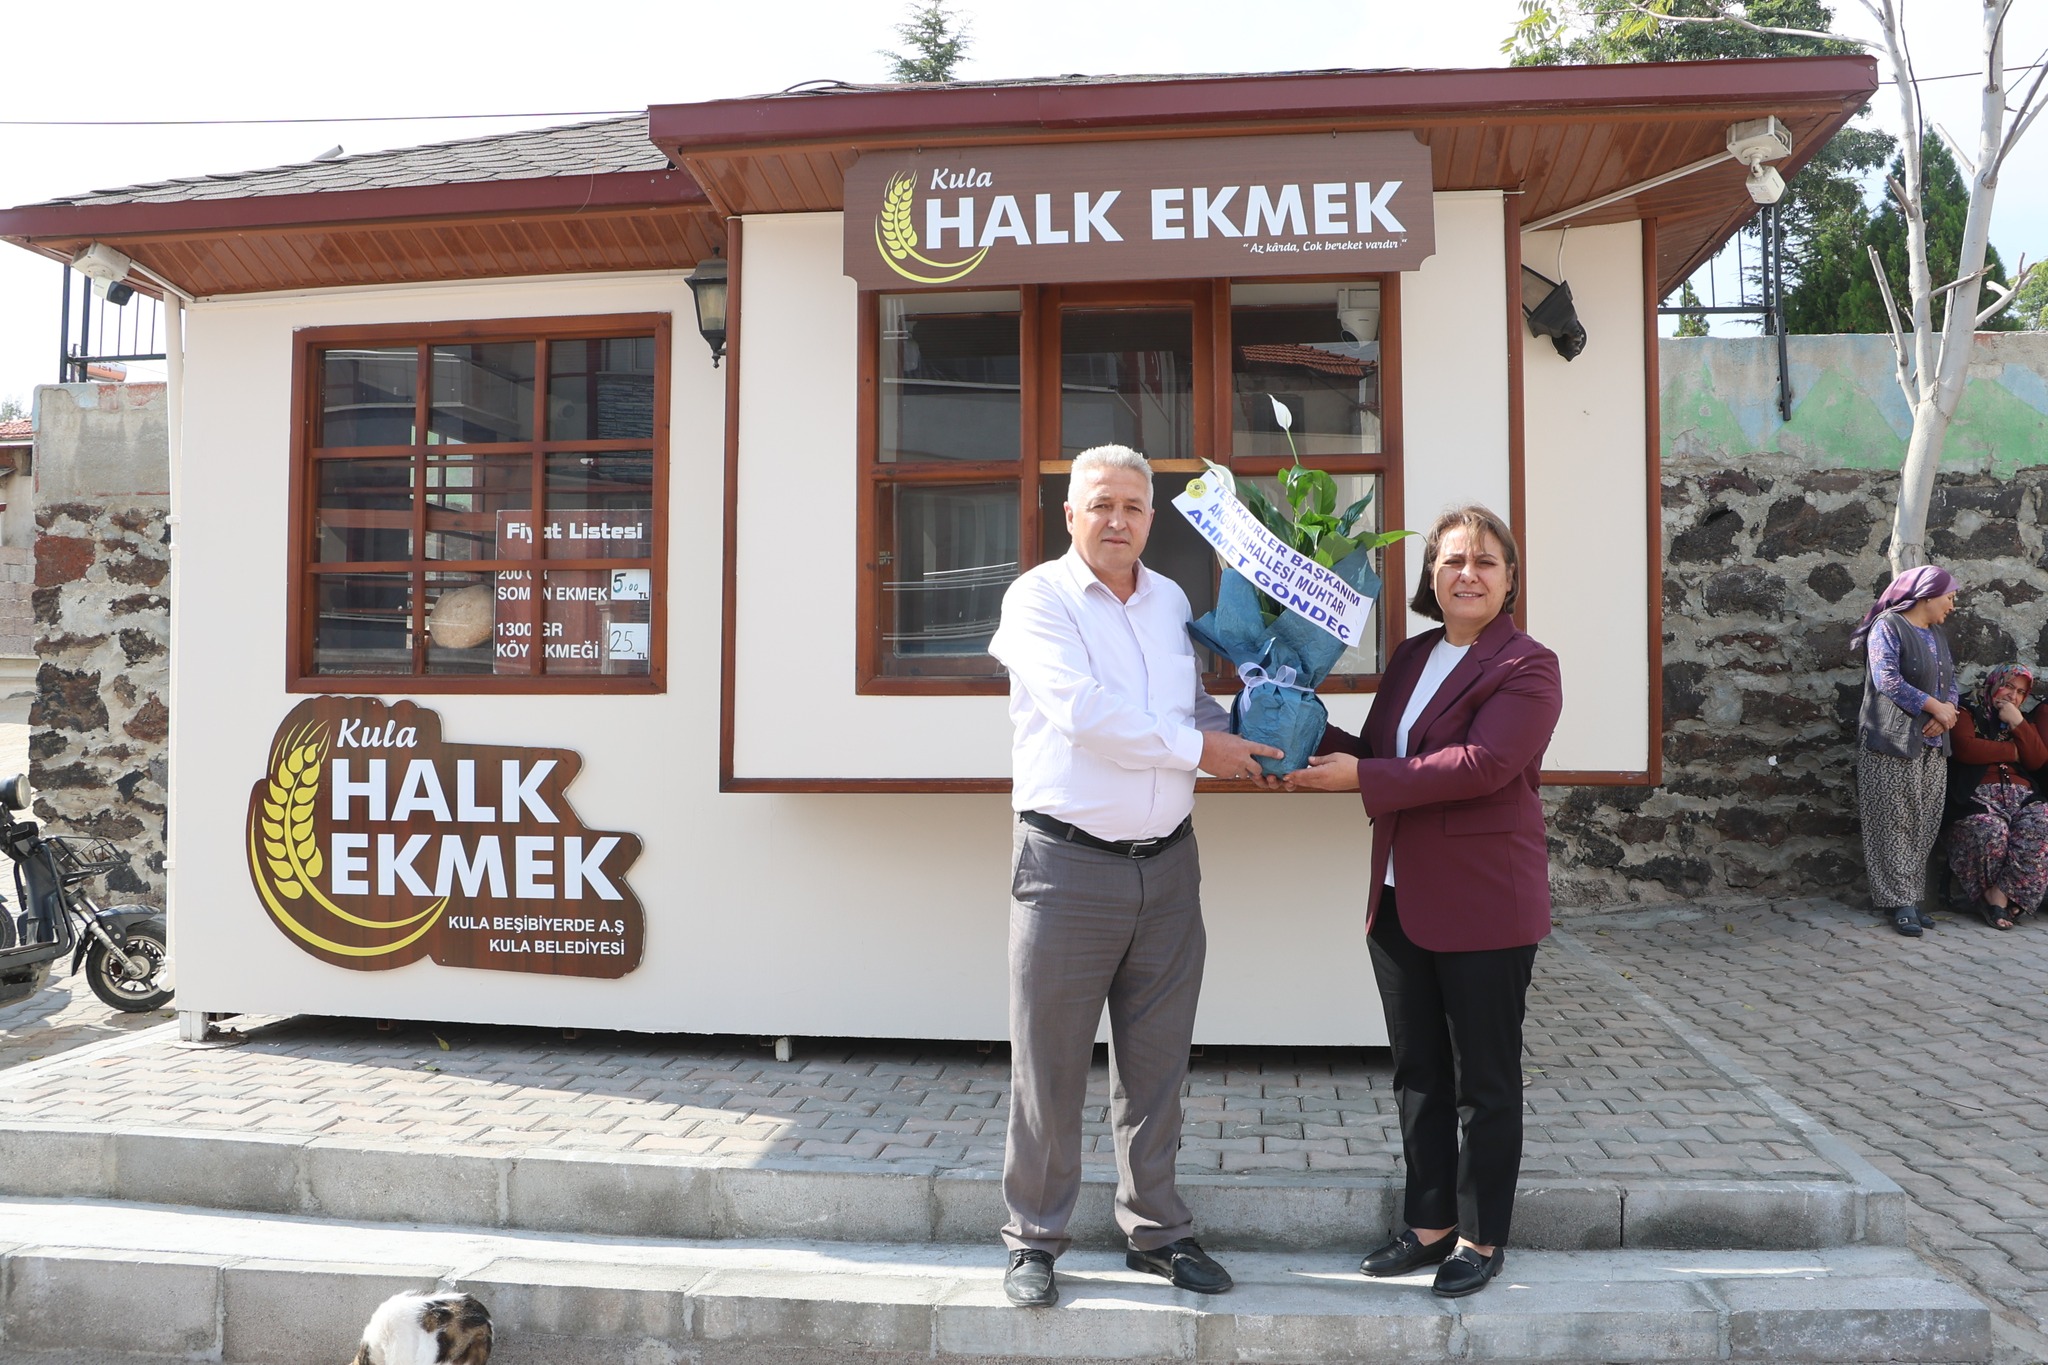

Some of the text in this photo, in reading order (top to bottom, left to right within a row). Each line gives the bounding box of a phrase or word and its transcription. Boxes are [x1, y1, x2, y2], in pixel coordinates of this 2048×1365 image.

[930, 167, 993, 190] Kula
[926, 180, 1407, 250] HALK EKMEK
[1325, 240, 1363, 250] bereket
[569, 522, 643, 539] Listesi
[1185, 509, 1351, 640] AHMET GÖNDEÇ
[1236, 529, 1297, 582] MAHALLESİ
[1295, 575, 1347, 617] MUHTARI
[1290, 553, 1361, 607] BAŞKANIM
[497, 586, 608, 601] SOMN EKMEK
[497, 622, 532, 636] 1300
[496, 640, 599, 658] KÖY KMEĞİ
[336, 718, 417, 749] Kula
[331, 758, 560, 823] HALK
[331, 833, 624, 900] EKMEK
[448, 914, 625, 935] KULA BEŞİBİYERDE A.Ş
[489, 938, 625, 955] KULA BELEDİYESİ
